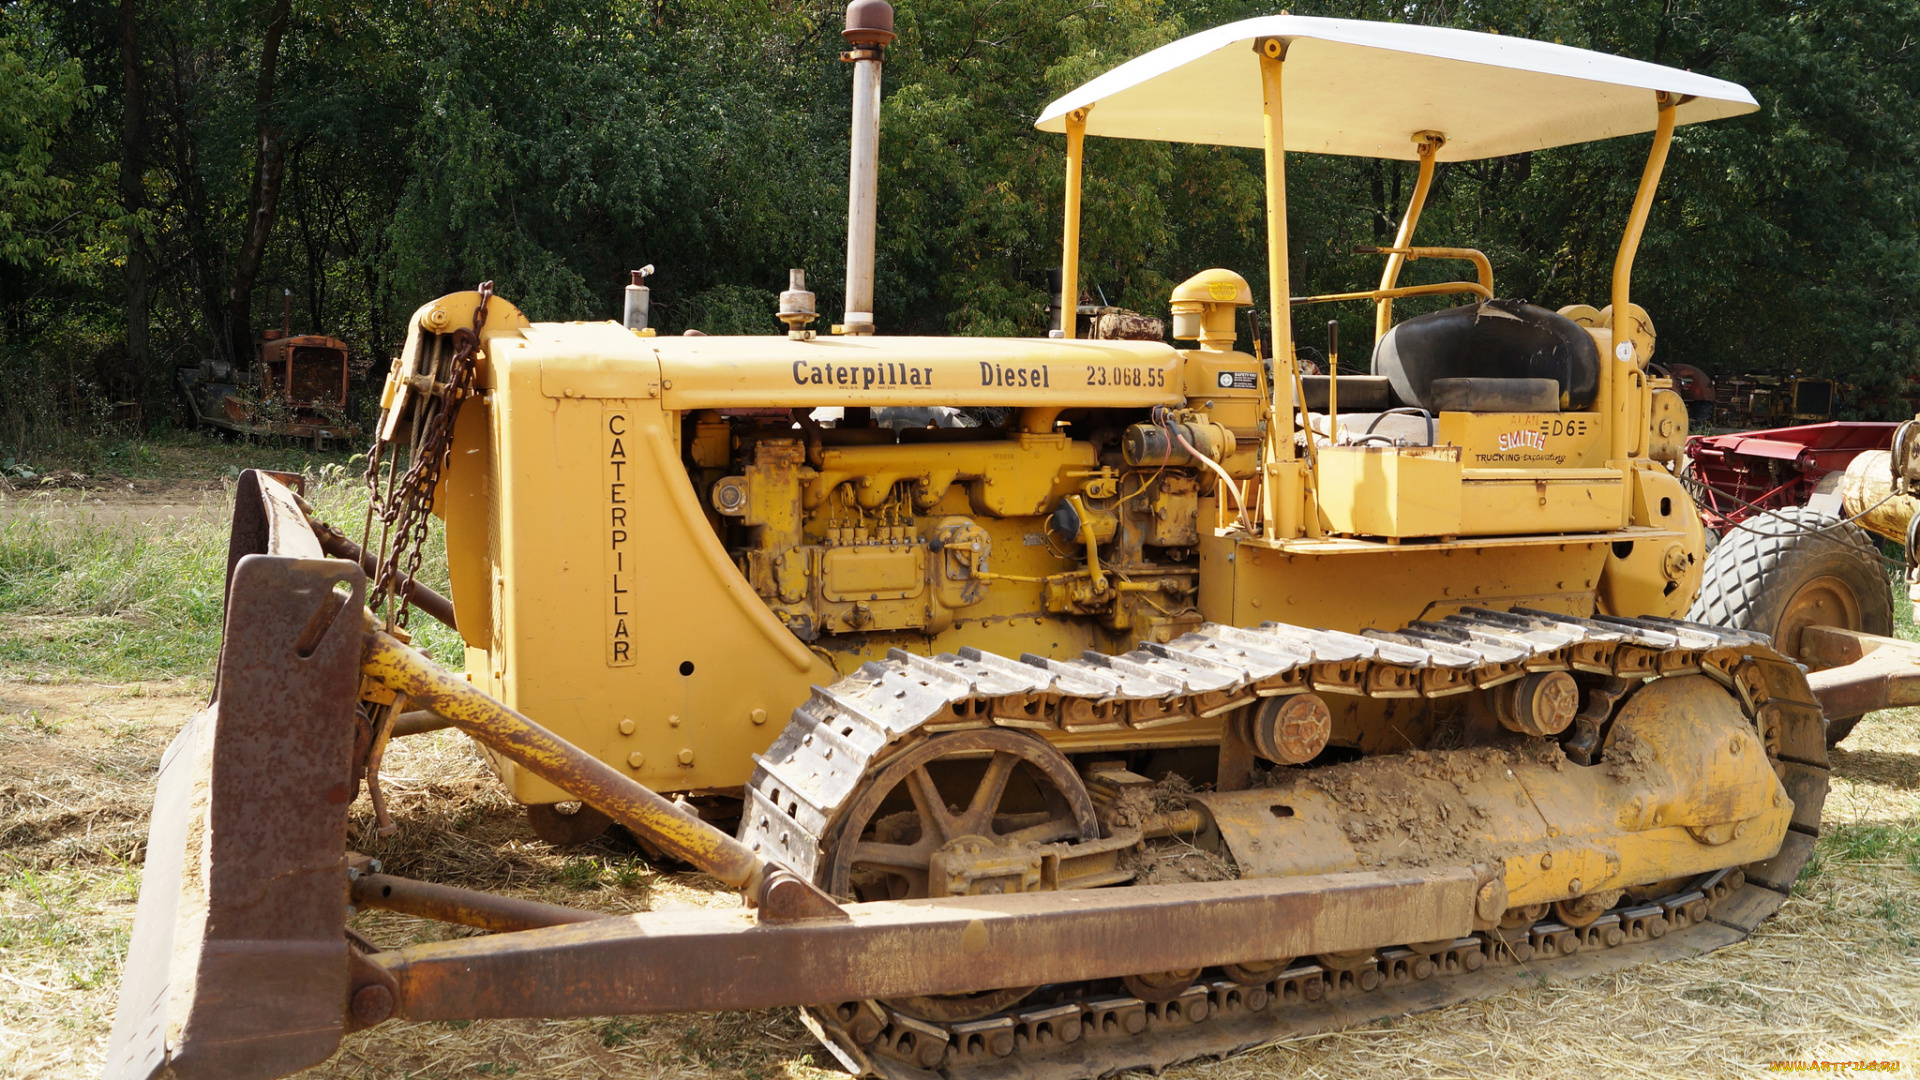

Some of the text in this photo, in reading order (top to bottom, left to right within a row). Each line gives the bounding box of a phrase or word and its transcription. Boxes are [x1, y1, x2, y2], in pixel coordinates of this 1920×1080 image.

[792, 360, 1165, 390] Caterpillar Diesel 23.068.55
[1498, 429, 1547, 452] SMITH
[1552, 419, 1576, 437] D6
[608, 414, 630, 663] CATERPILLAR
